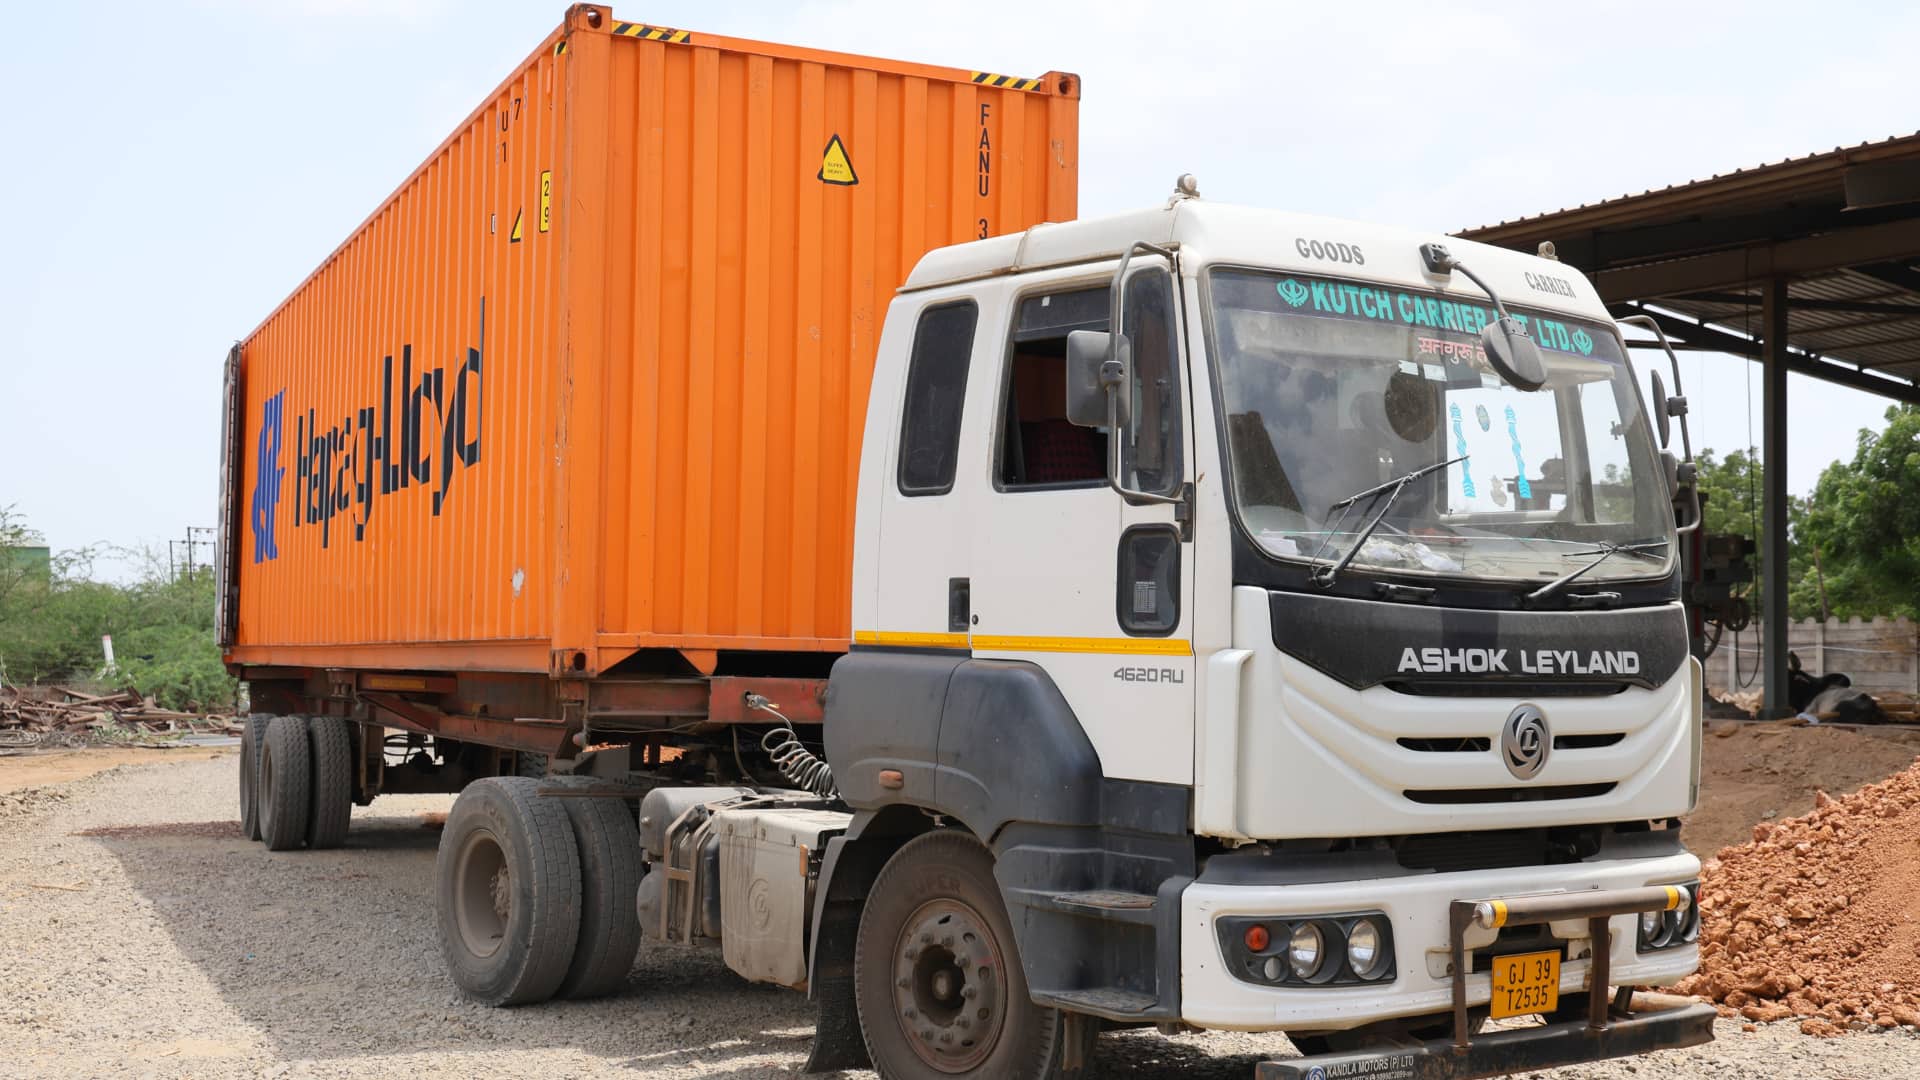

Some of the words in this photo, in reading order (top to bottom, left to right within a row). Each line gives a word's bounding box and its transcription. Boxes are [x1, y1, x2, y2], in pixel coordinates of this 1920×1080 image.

[979, 104, 990, 196] FANU
[1295, 238, 1365, 265] GOODS
[1524, 271, 1577, 299] CARRIER
[1311, 280, 1394, 320] KUTCH
[1398, 294, 1487, 334] CARRIER
[1535, 318, 1576, 353] LTD.
[295, 296, 485, 549] Hapag-Lloyd
[1397, 648, 1511, 673] ASHOK
[1520, 649, 1640, 674] LEYLAND
[1113, 667, 1158, 682] 4620
[1509, 962, 1526, 984] GJ
[1535, 958, 1551, 981] 39
[1507, 985, 1548, 1011] T2535
[1326, 1063, 1357, 1077] KANDLA
[1358, 1058, 1390, 1073] MOTORS
[1390, 1055, 1400, 1072] (P)
